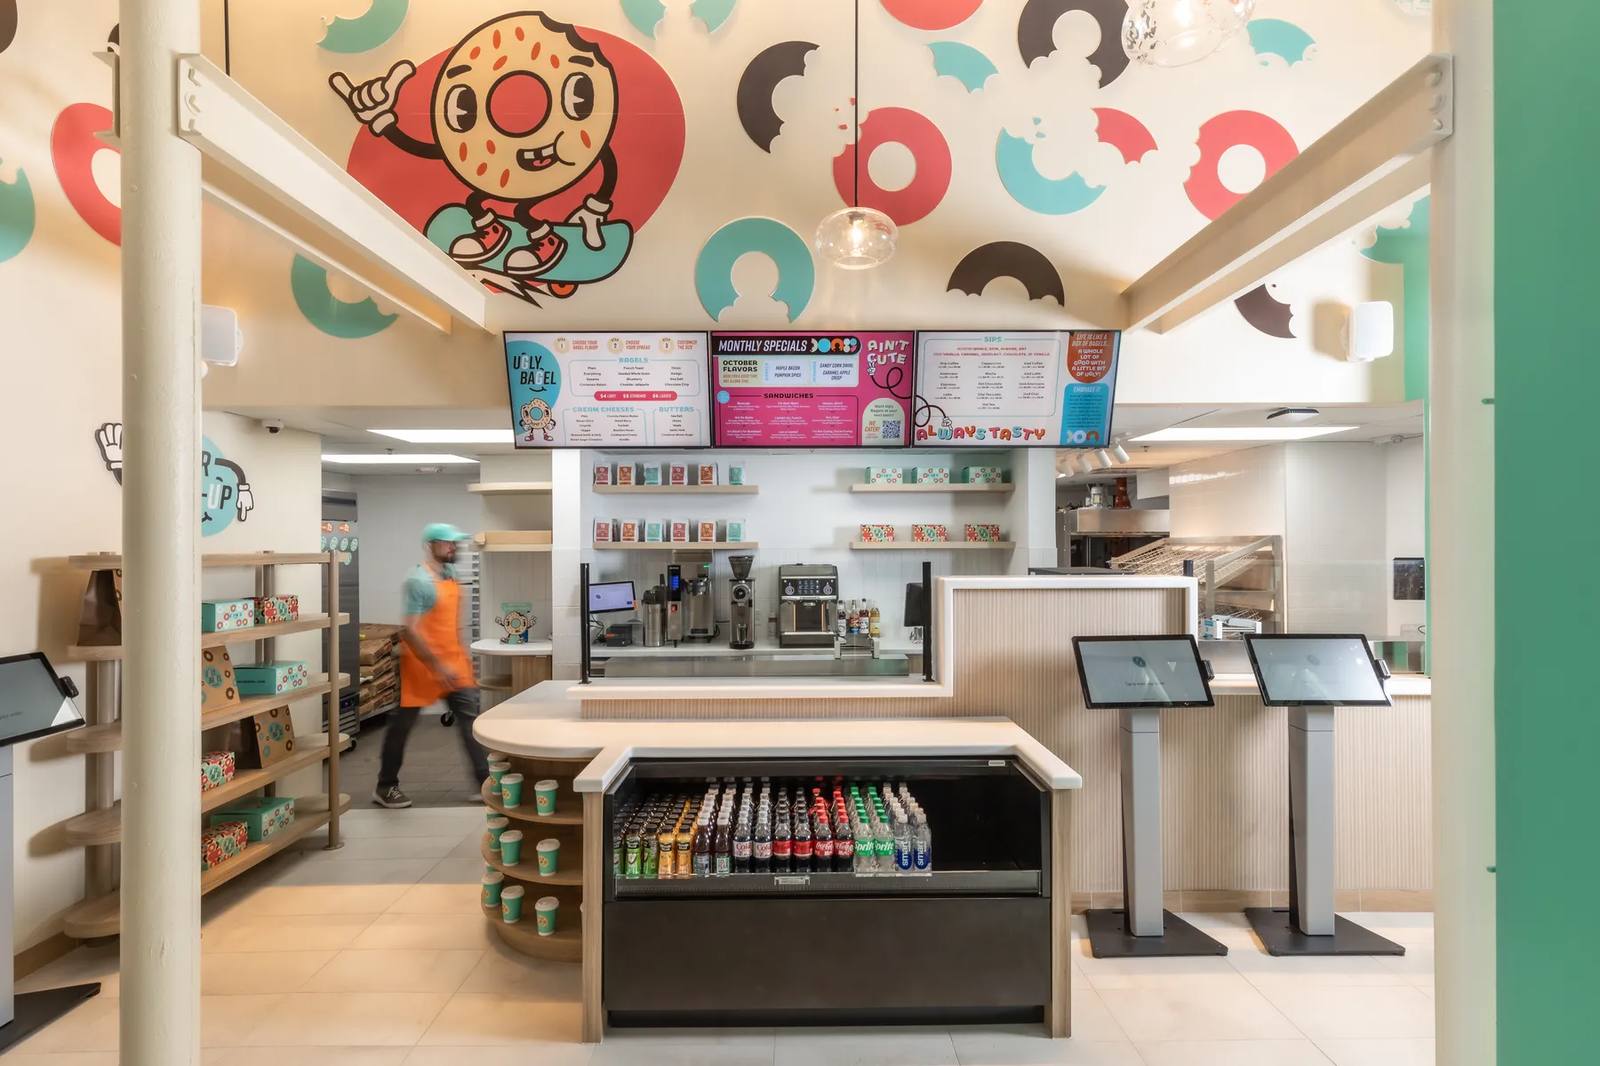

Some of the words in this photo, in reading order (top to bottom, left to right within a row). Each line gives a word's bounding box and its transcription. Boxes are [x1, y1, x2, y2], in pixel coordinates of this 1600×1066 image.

[719, 340, 762, 352] MONTHLY
[763, 340, 807, 352] SPECIALS
[868, 340, 909, 352] AIN'T
[514, 356, 542, 370] UGLY
[867, 353, 907, 365] CUTE
[520, 371, 556, 385] BAGEL
[916, 425, 986, 440] ALWAYS
[988, 426, 1046, 440] TASTY
